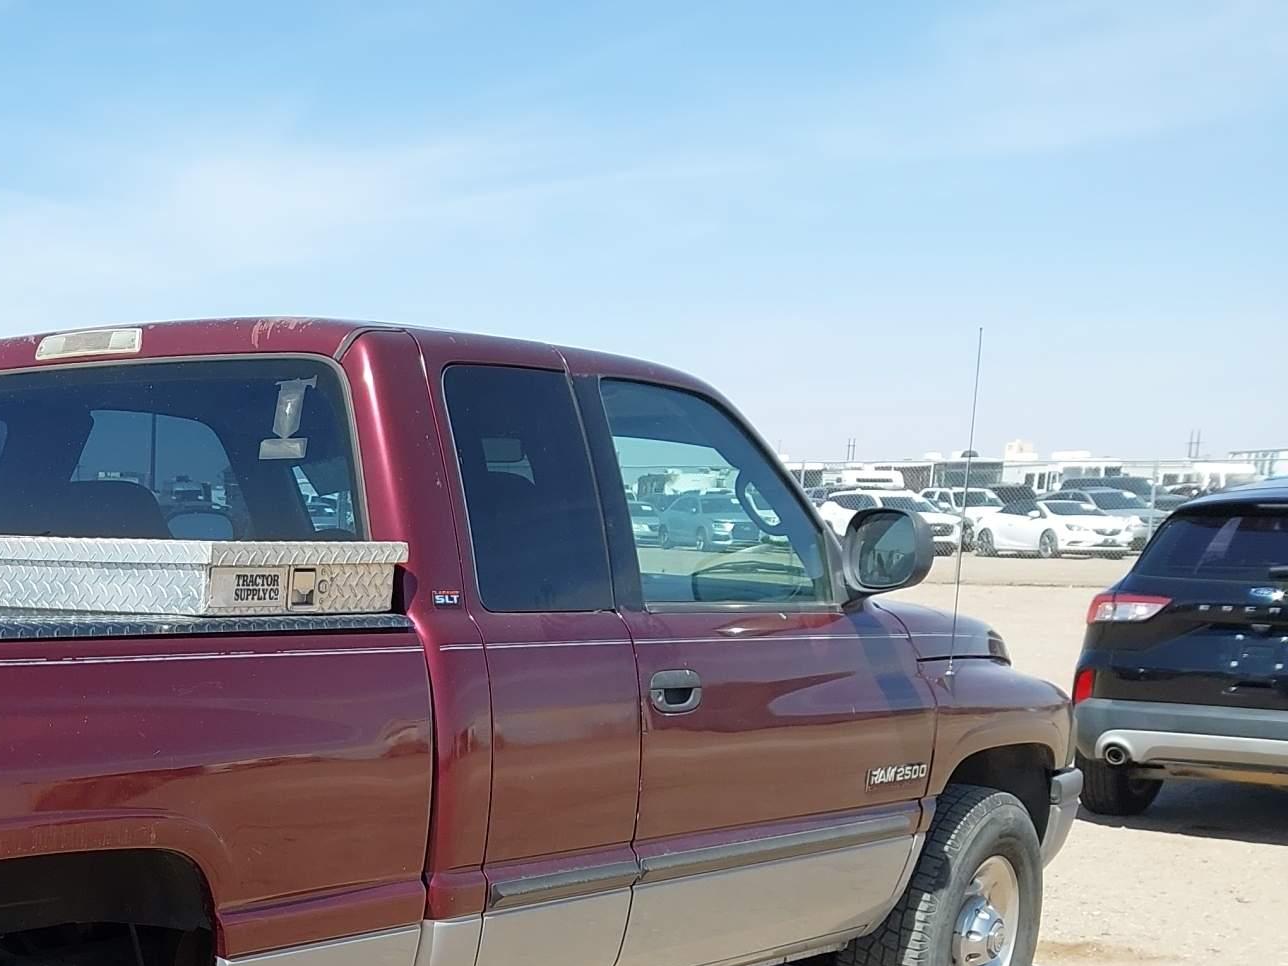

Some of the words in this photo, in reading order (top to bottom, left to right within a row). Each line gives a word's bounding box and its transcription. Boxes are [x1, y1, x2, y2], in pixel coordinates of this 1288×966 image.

[235, 574, 280, 587] TRACTOR
[234, 588, 268, 601] SUPPLY
[435, 594, 460, 604] SLT
[870, 766, 898, 785] RAM
[896, 764, 928, 782] 2500
